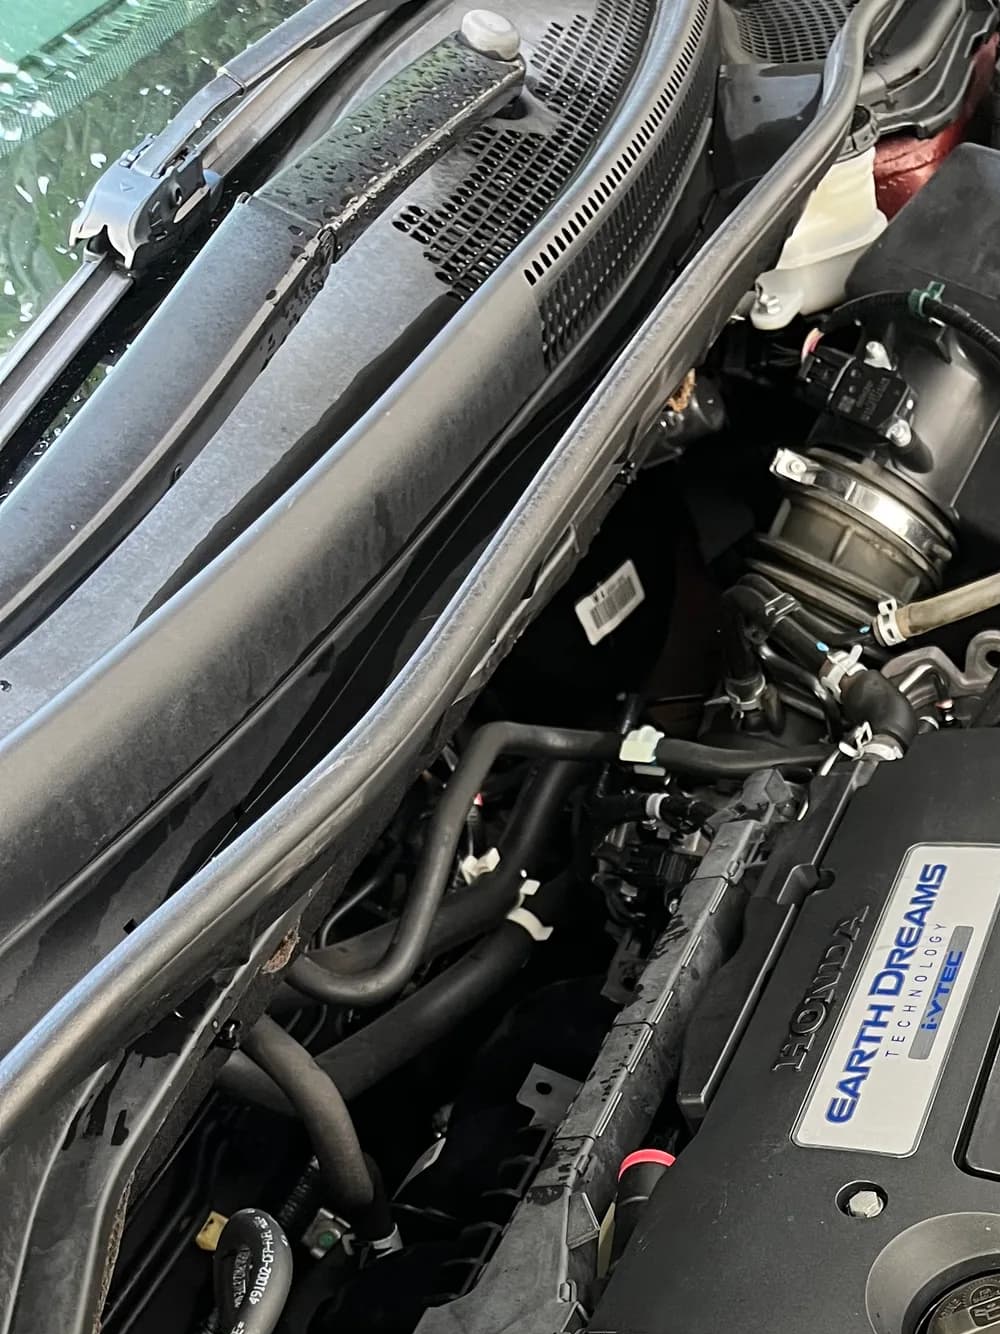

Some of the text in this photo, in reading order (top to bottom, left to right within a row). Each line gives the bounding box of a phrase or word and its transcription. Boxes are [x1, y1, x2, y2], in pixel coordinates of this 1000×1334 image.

[772, 904, 870, 1072] HONDA
[825, 863, 948, 1124] EARTH DREAMS
[885, 922, 947, 1057] TECHNOLOGY
[920, 950, 963, 1031] i-VTEC
